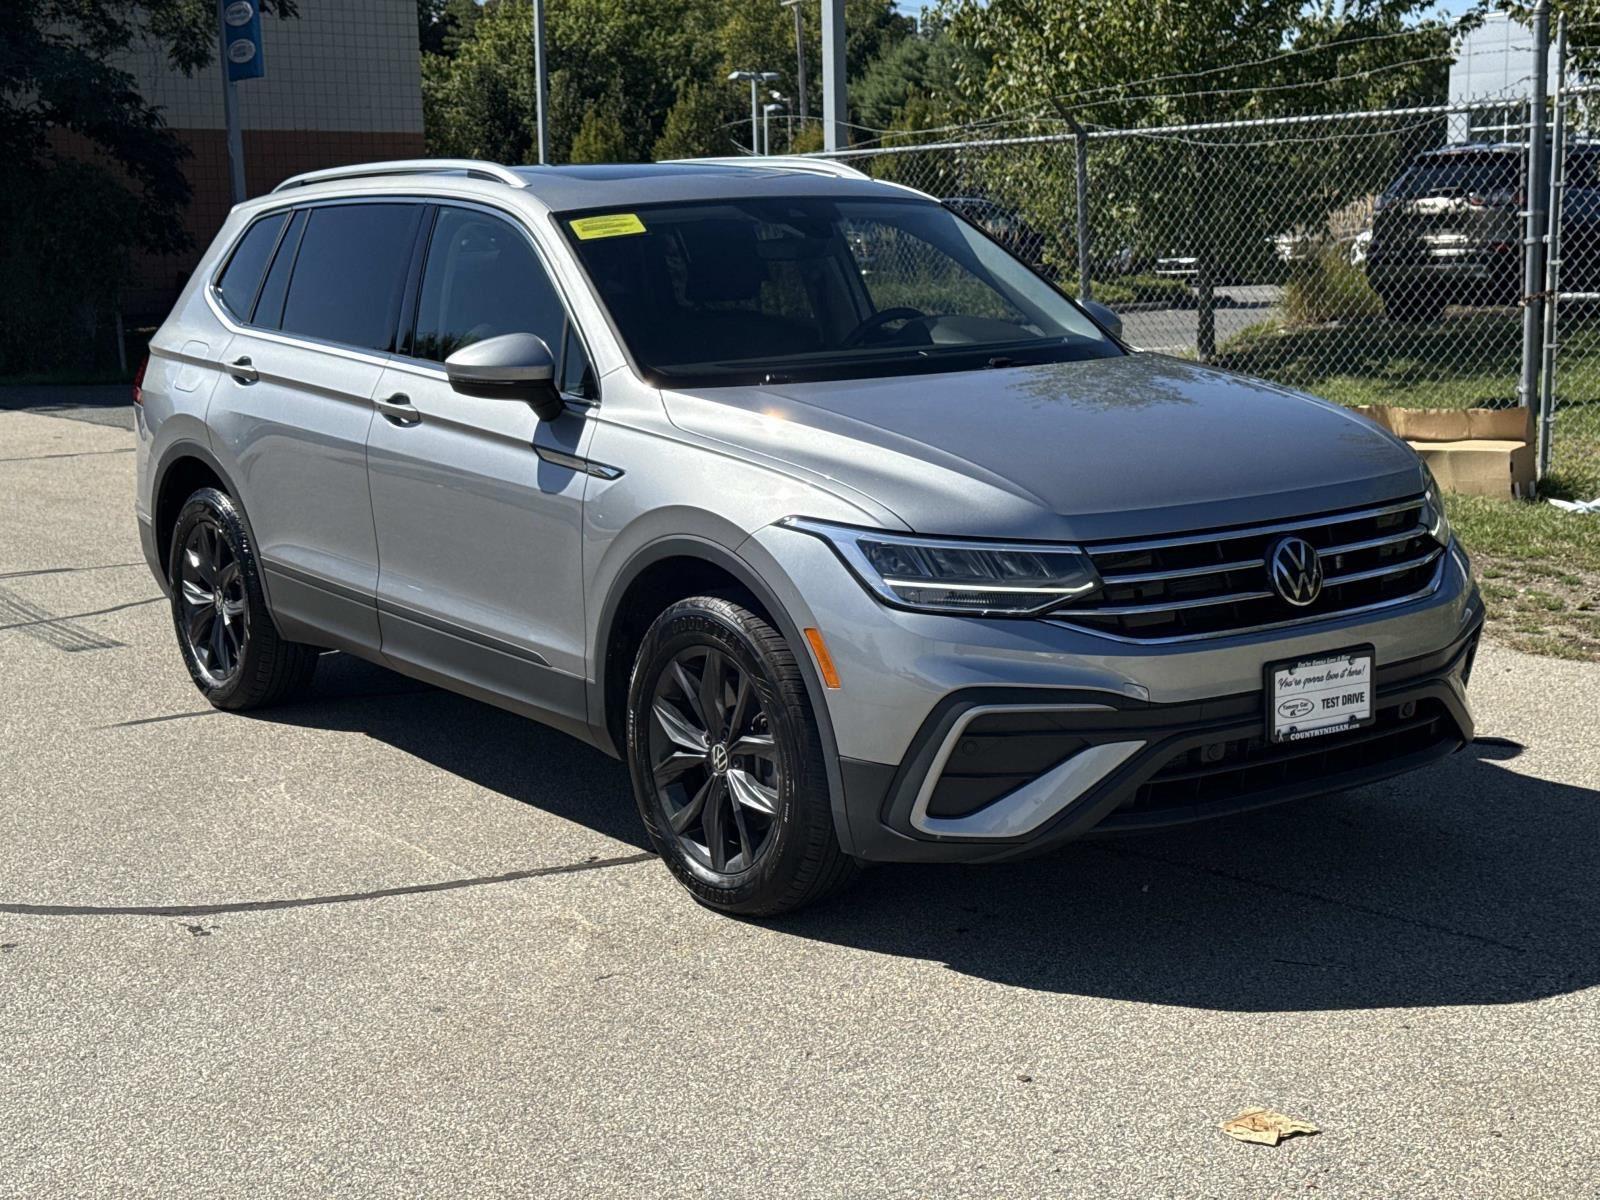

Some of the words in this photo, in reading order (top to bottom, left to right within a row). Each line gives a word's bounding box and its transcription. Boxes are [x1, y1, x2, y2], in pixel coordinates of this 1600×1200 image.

[1325, 670, 1339, 681] love
[1340, 668, 1348, 678] it
[1321, 696, 1340, 710] TEST
[1342, 691, 1365, 706] DRIVE
